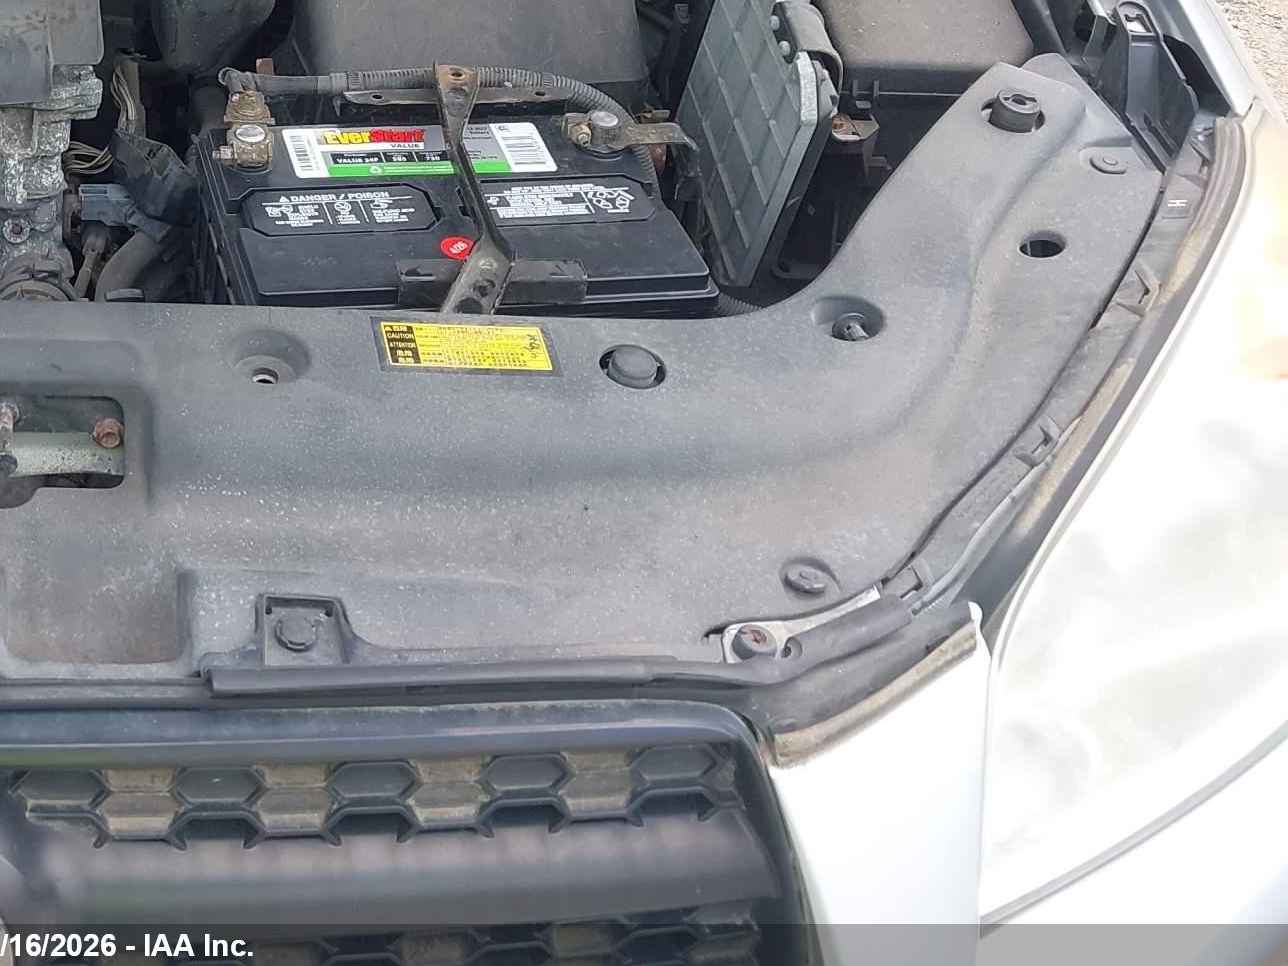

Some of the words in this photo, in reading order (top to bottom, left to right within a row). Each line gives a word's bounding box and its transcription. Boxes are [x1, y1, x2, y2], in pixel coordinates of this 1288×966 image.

[324, 128, 425, 144] EverStart
[290, 194, 336, 203] DANGER
[348, 191, 390, 200] POISON
[387, 332, 414, 340] CAUTION
[389, 341, 416, 349] ATTENTION
